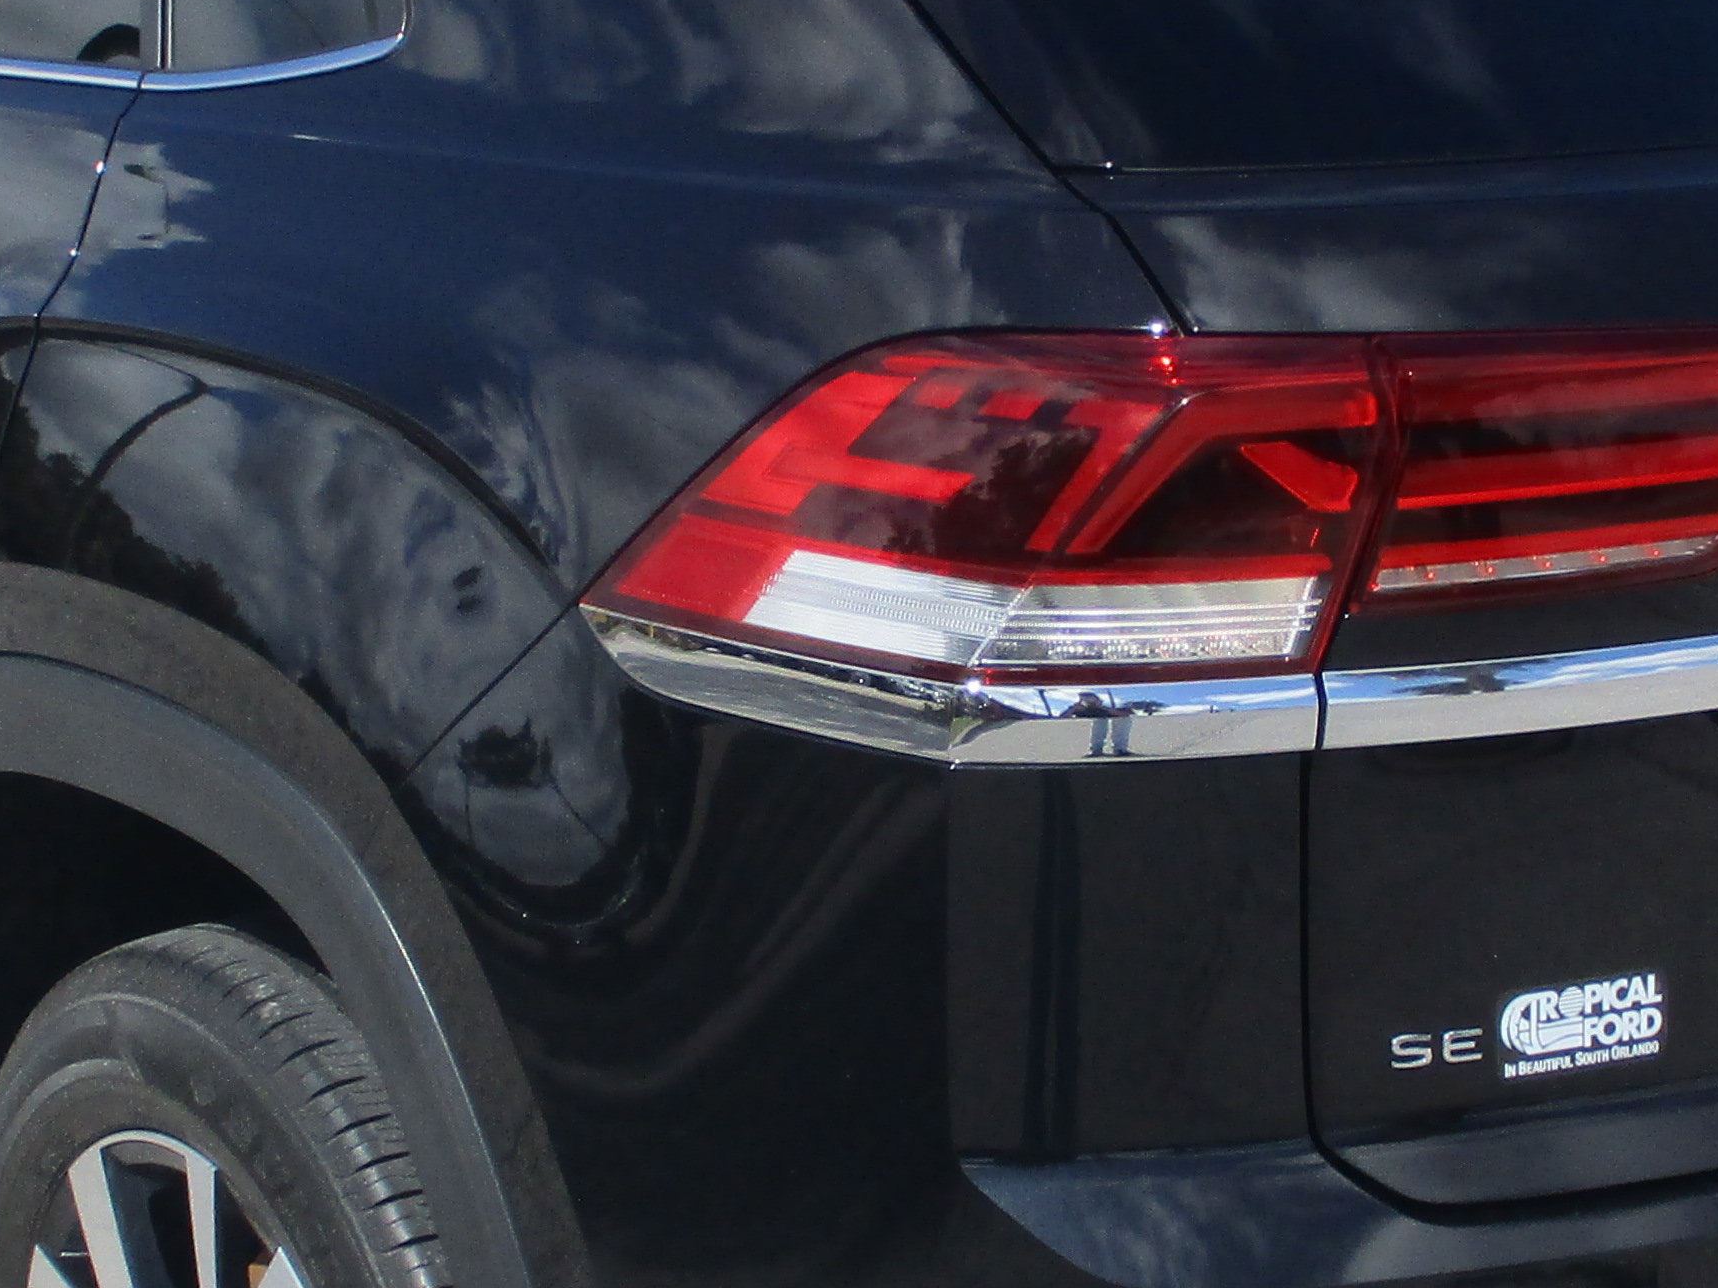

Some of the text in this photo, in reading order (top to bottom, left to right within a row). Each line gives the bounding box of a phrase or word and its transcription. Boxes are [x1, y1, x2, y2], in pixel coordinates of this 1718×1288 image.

[1519, 973, 1663, 1024] TROPICAL
[1583, 1007, 1664, 1048] FORD
[1391, 1028, 1483, 1069] SE
